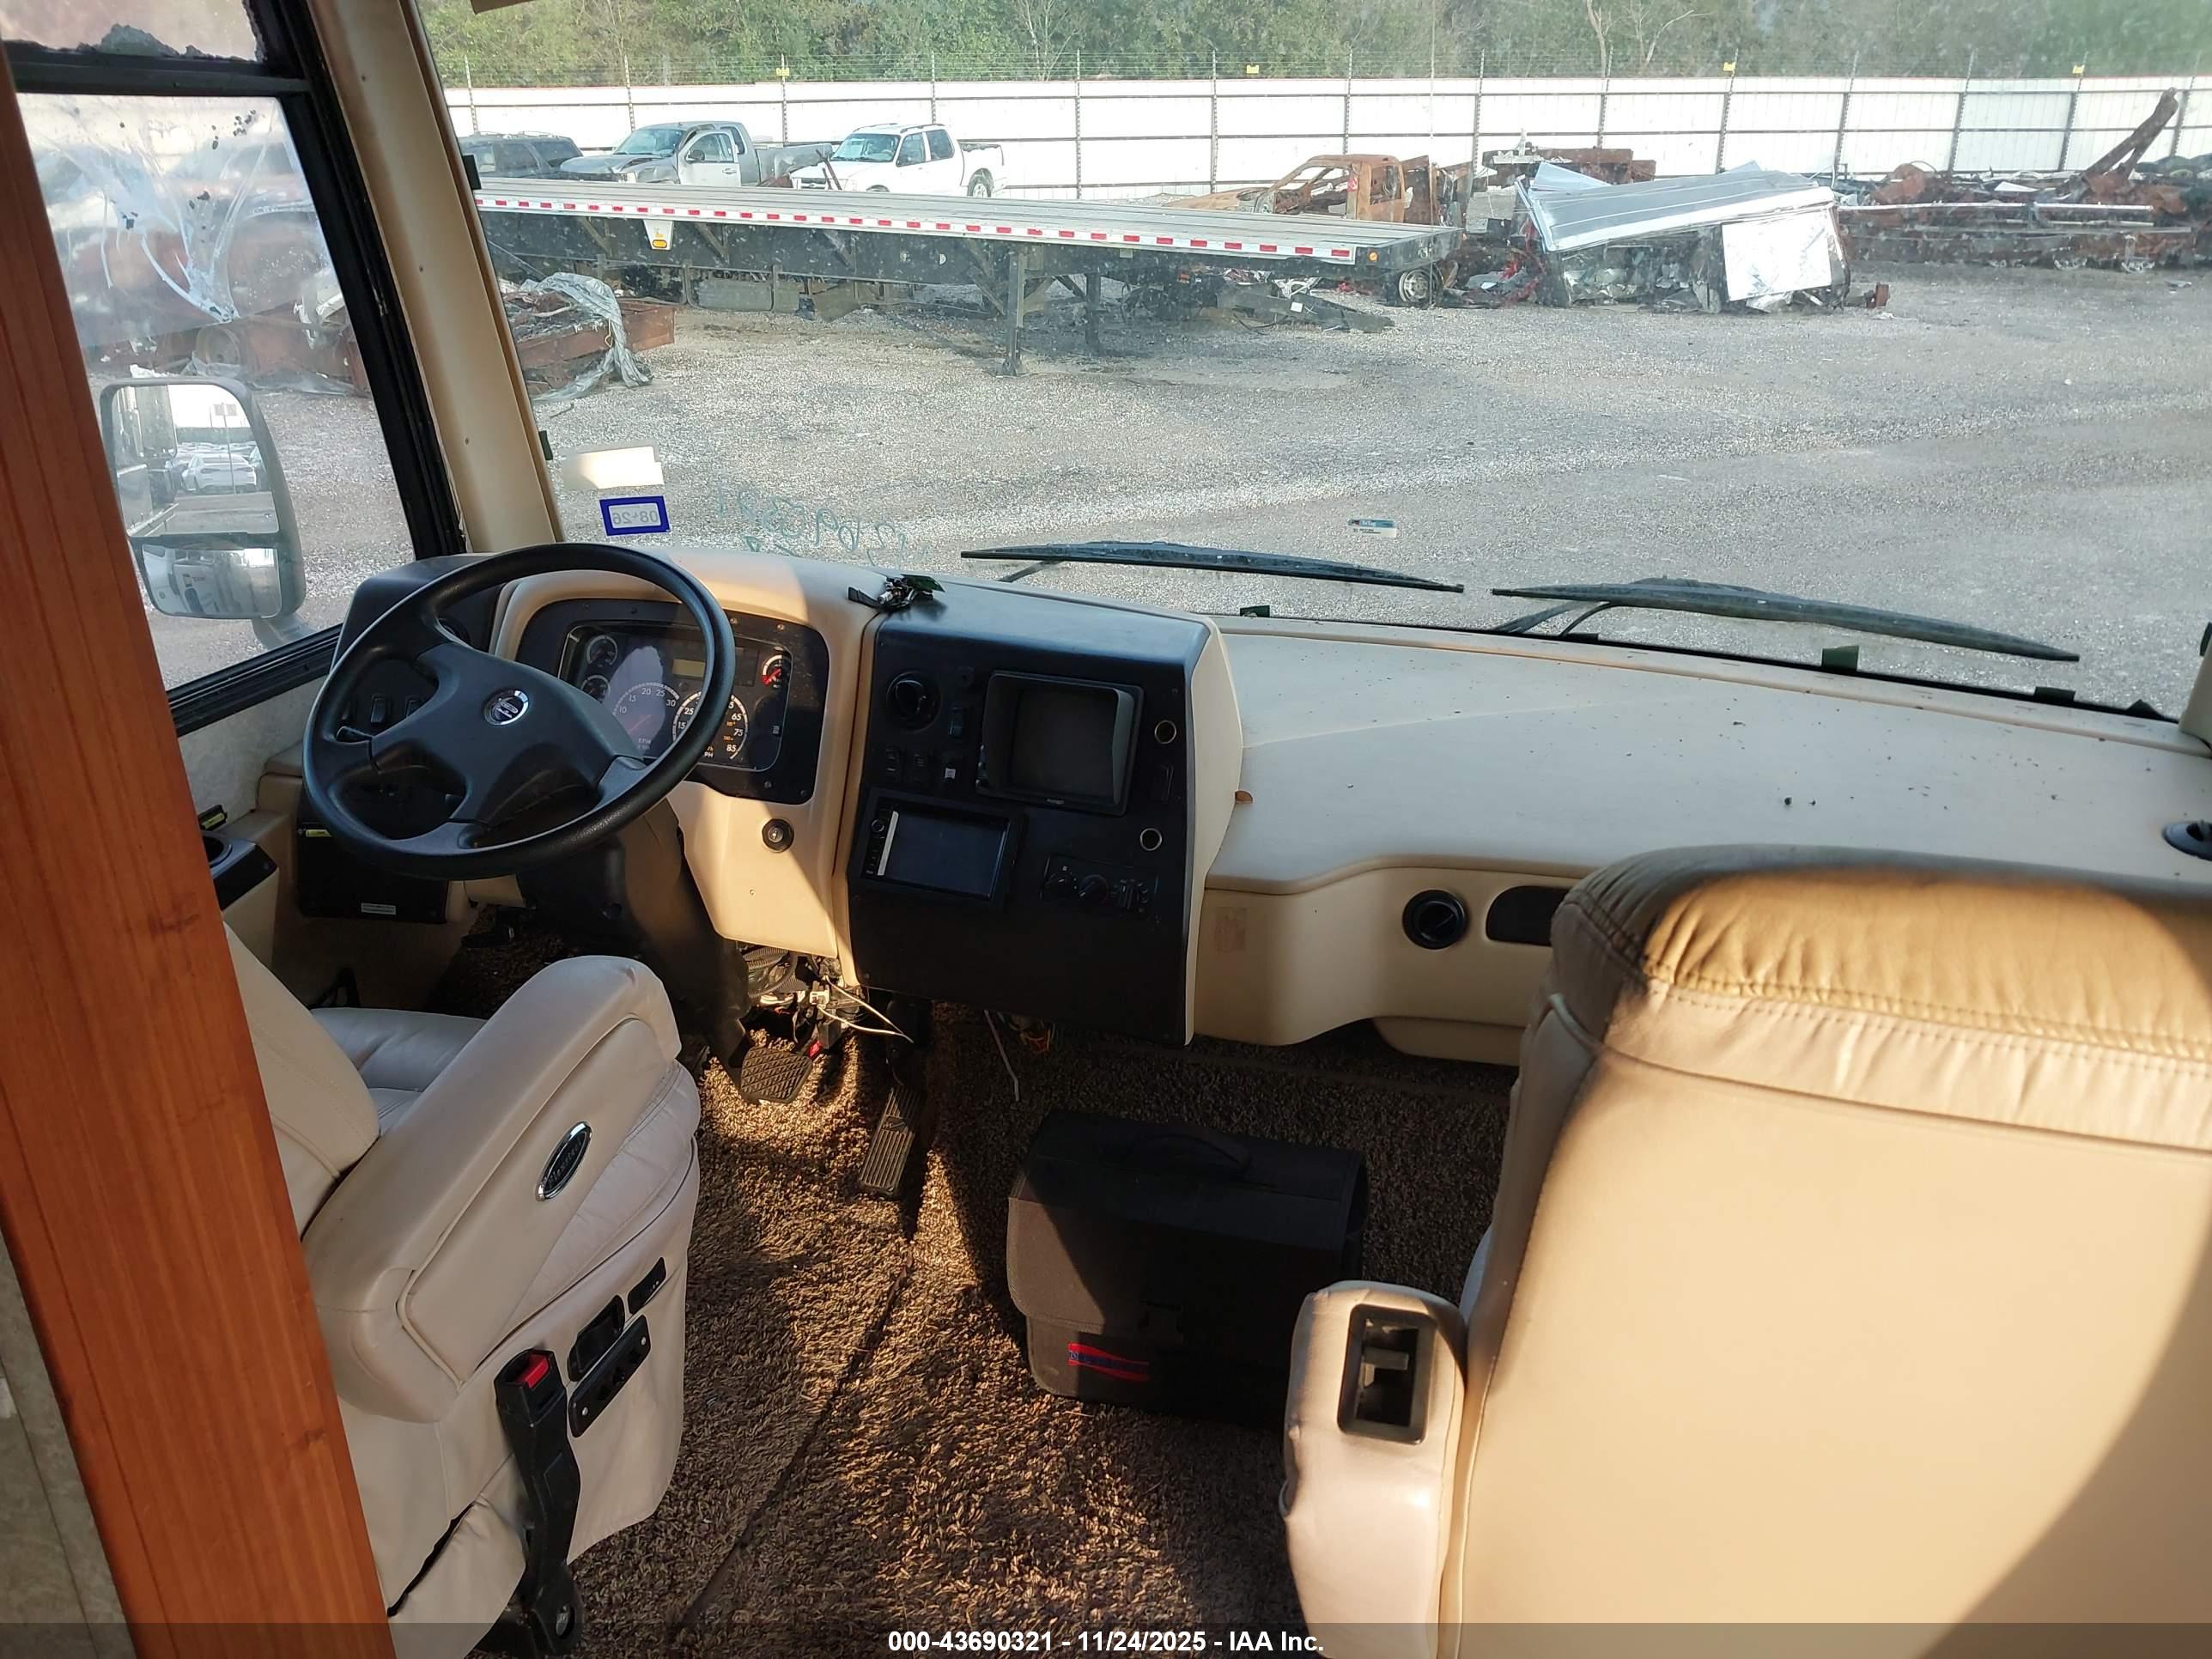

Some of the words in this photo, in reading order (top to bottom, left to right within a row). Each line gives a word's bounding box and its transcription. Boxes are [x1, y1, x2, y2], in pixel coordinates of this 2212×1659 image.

[641, 687, 651, 696] 20
[656, 689, 665, 697] 25
[629, 694, 637, 702] 15
[665, 699, 676, 708] 30
[684, 707, 695, 715] 25
[731, 713, 742, 721] 65
[678, 721, 686, 730] 15
[733, 728, 744, 737] 75
[726, 744, 737, 753] 85
